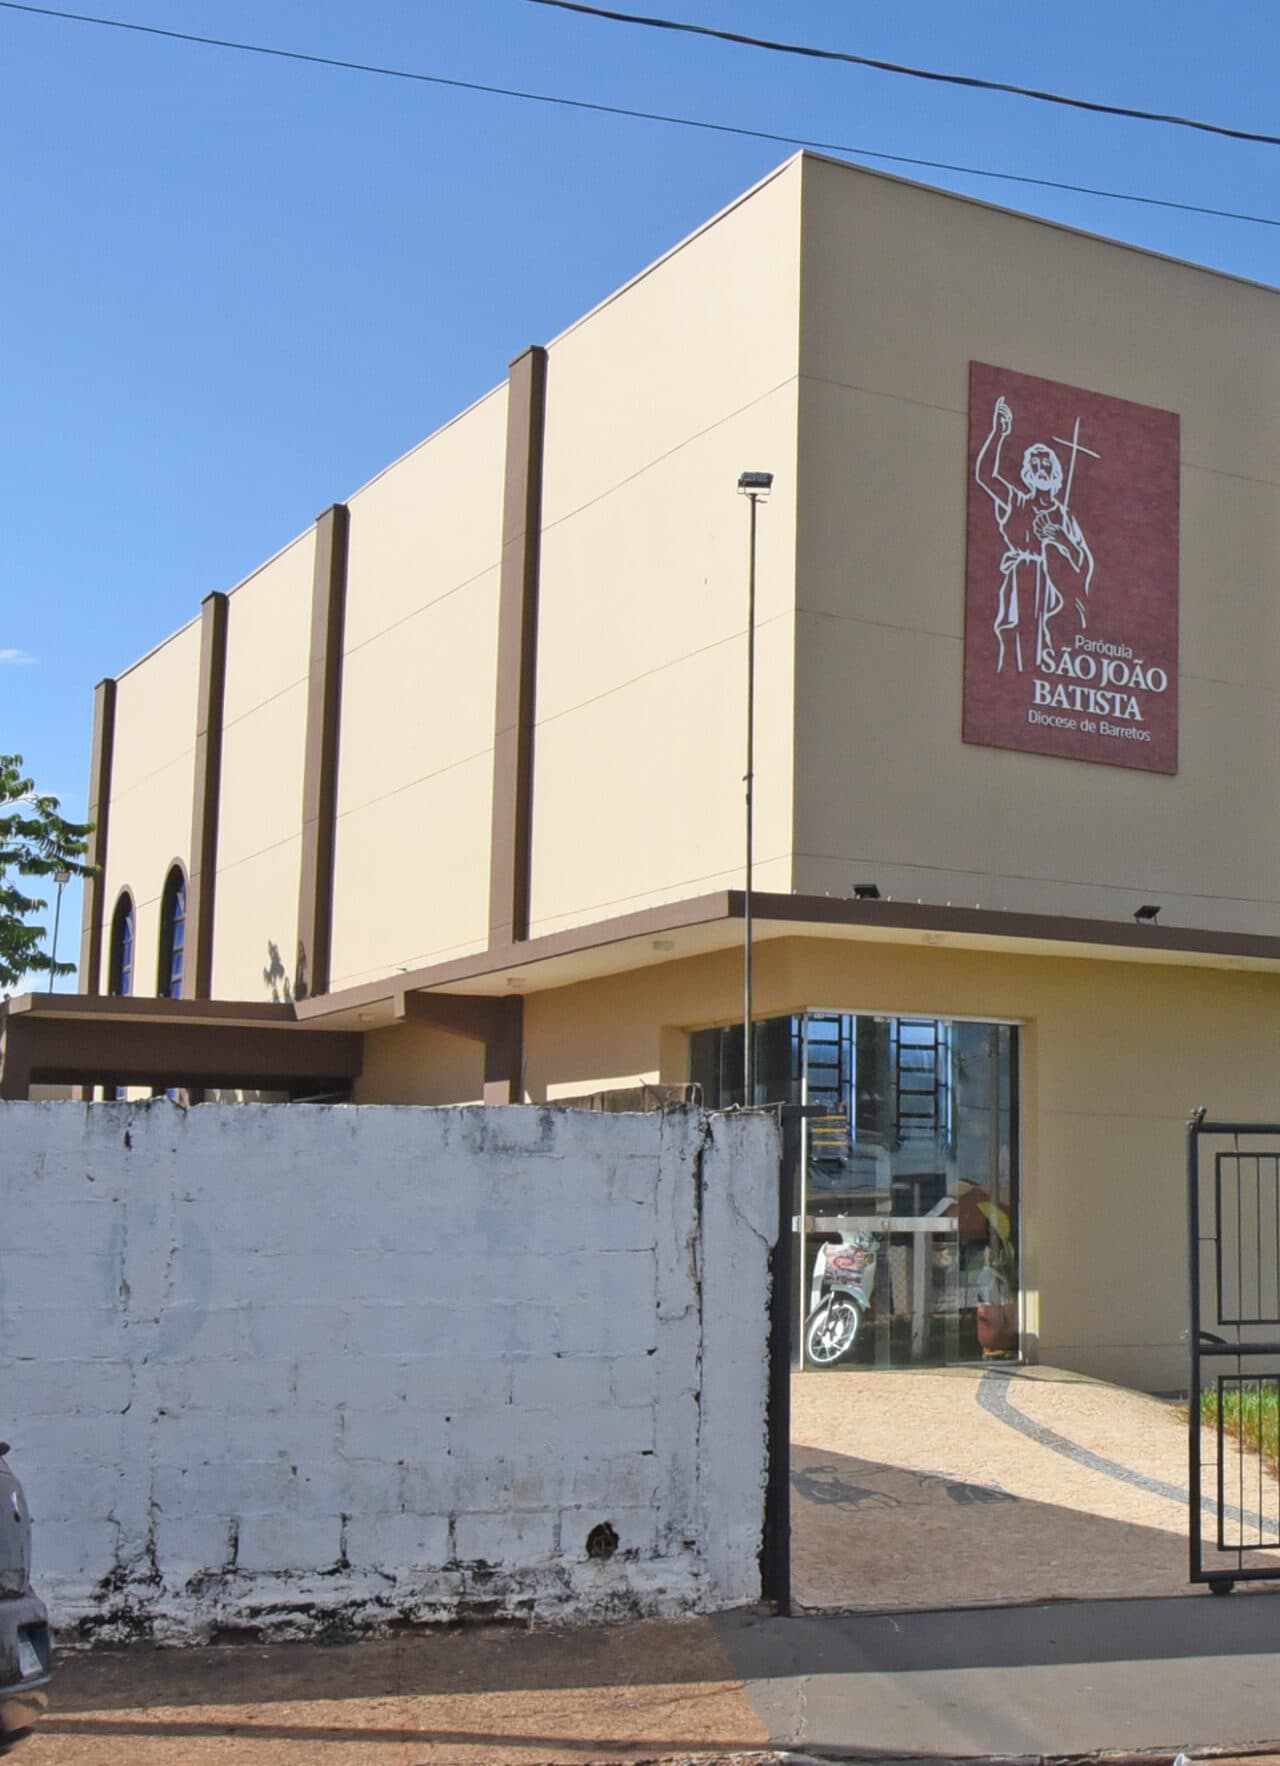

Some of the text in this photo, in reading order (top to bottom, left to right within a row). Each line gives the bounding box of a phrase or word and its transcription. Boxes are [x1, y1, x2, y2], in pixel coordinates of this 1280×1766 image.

[1075, 634, 1133, 659] Paróquia
[1041, 647, 1168, 693] SÃO JOÃO
[1032, 679, 1144, 721] BATISTA
[1028, 710, 1151, 742] Diocese de Barretos
